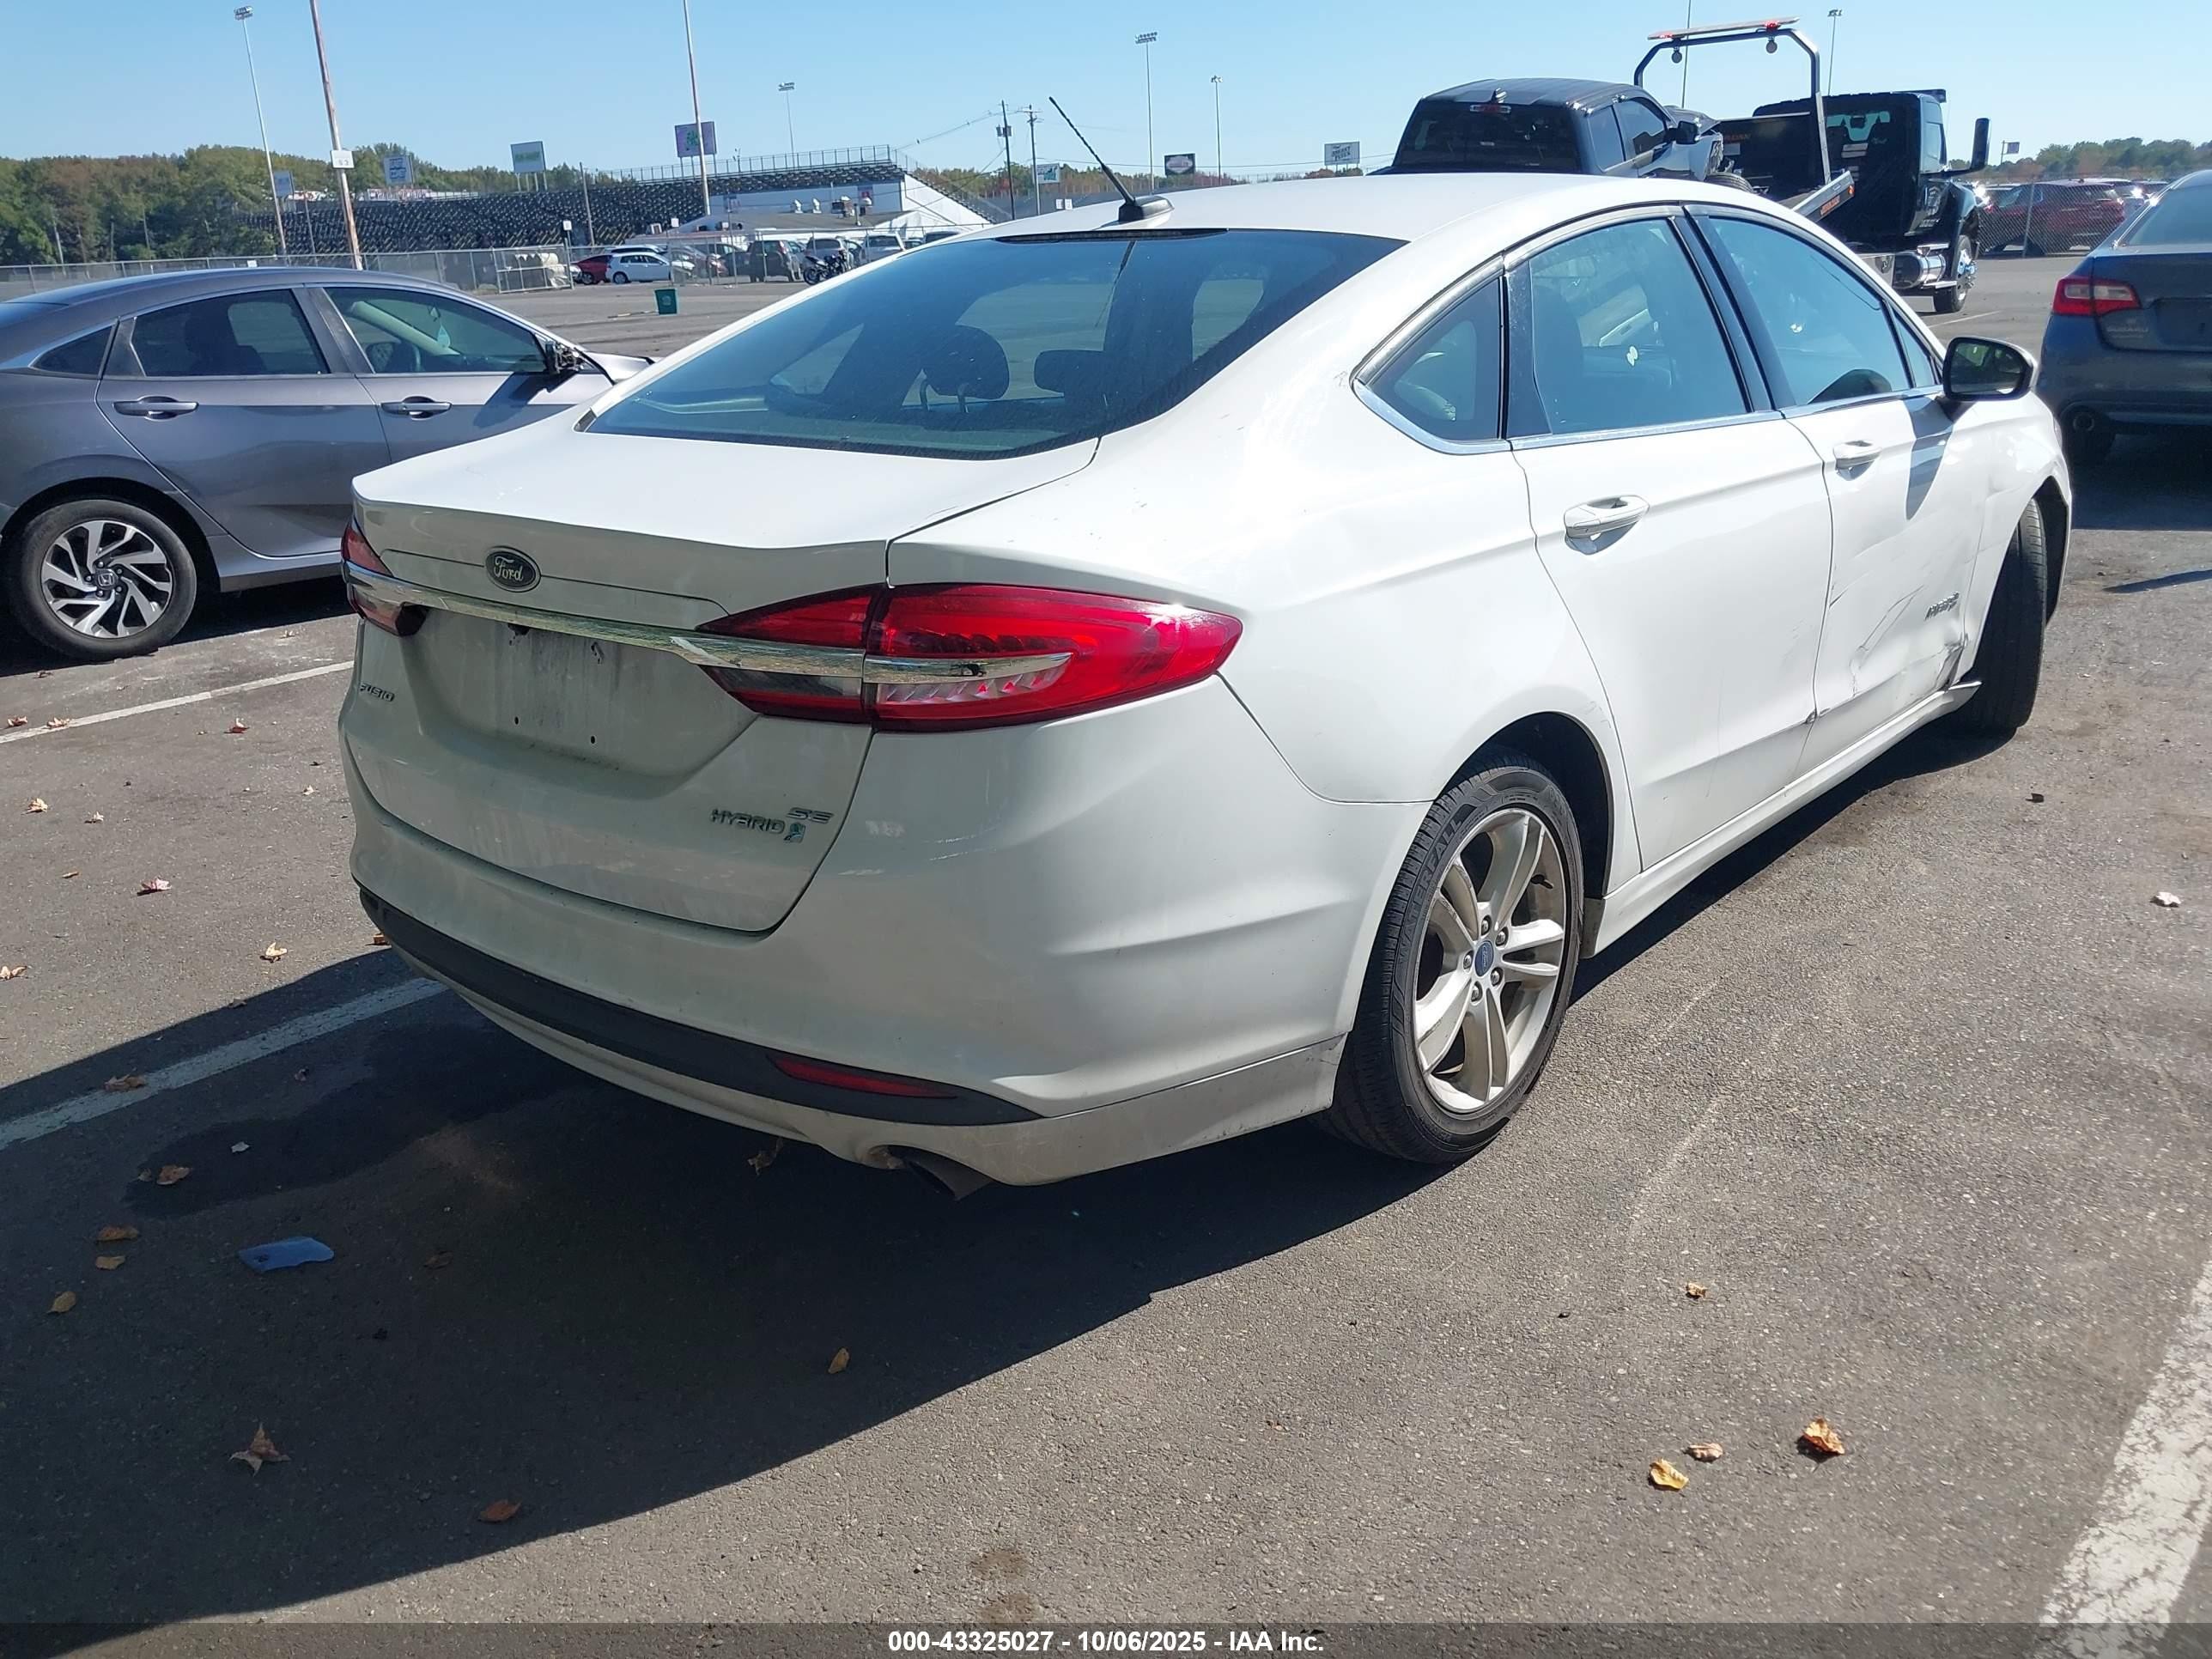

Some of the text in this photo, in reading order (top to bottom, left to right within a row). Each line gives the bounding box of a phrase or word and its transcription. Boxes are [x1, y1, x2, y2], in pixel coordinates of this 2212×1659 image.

[494, 556, 524, 581] Ford
[711, 809, 786, 835] HYBRID
[786, 807, 835, 824] SE
[1398, 818, 1462, 964] WATERFALL
